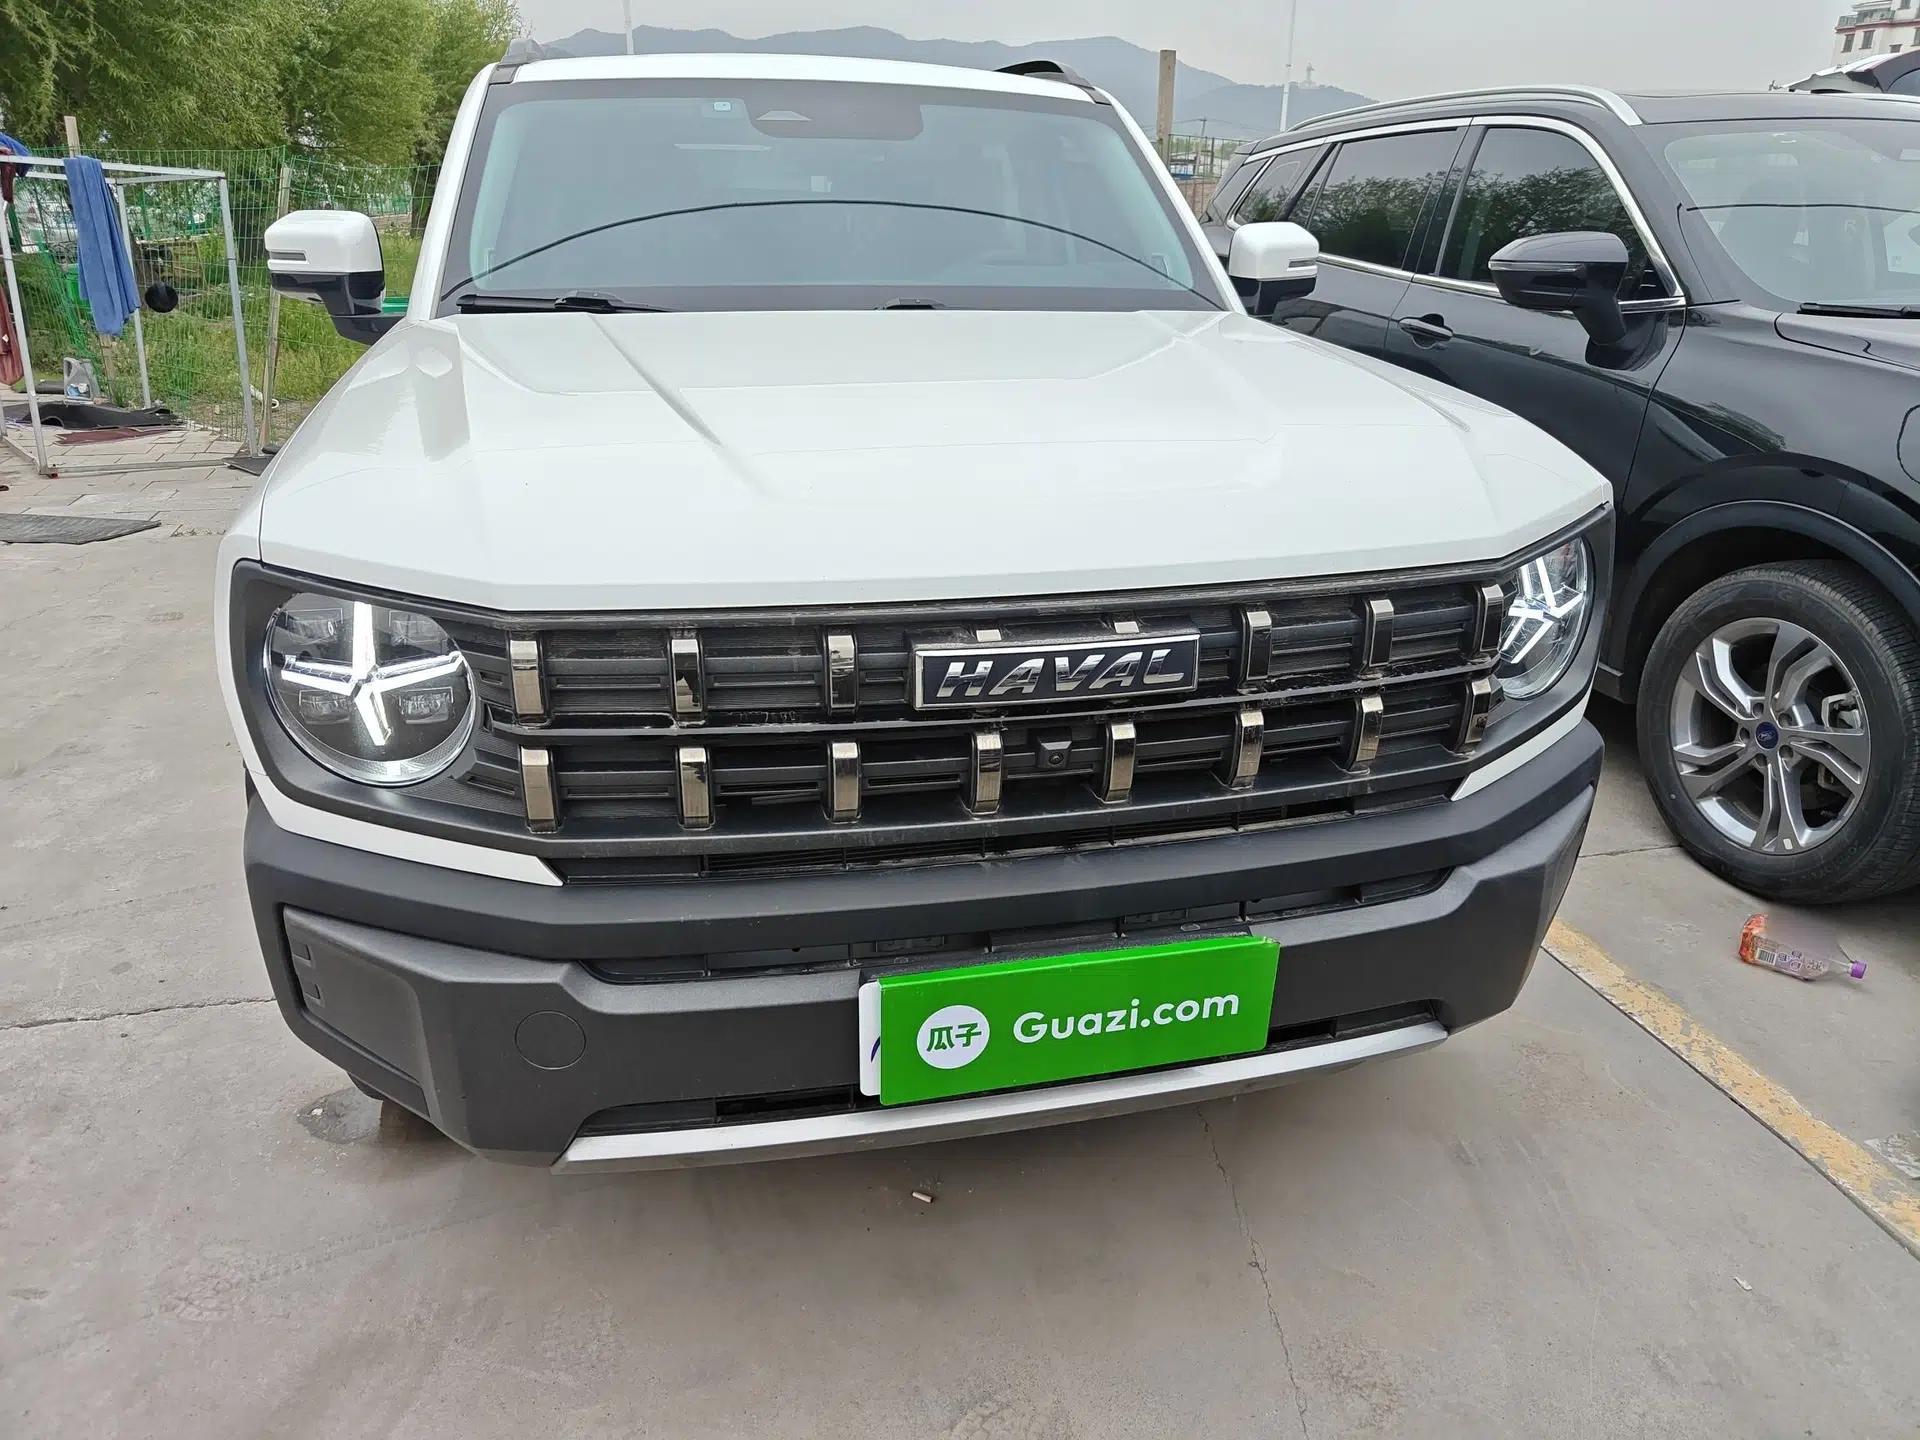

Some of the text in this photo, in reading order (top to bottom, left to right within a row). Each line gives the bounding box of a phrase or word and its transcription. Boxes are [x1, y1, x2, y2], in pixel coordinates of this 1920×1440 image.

[936, 649, 1184, 698] HAVAL
[926, 993, 1239, 1053] 瓜子 Guazi.com
